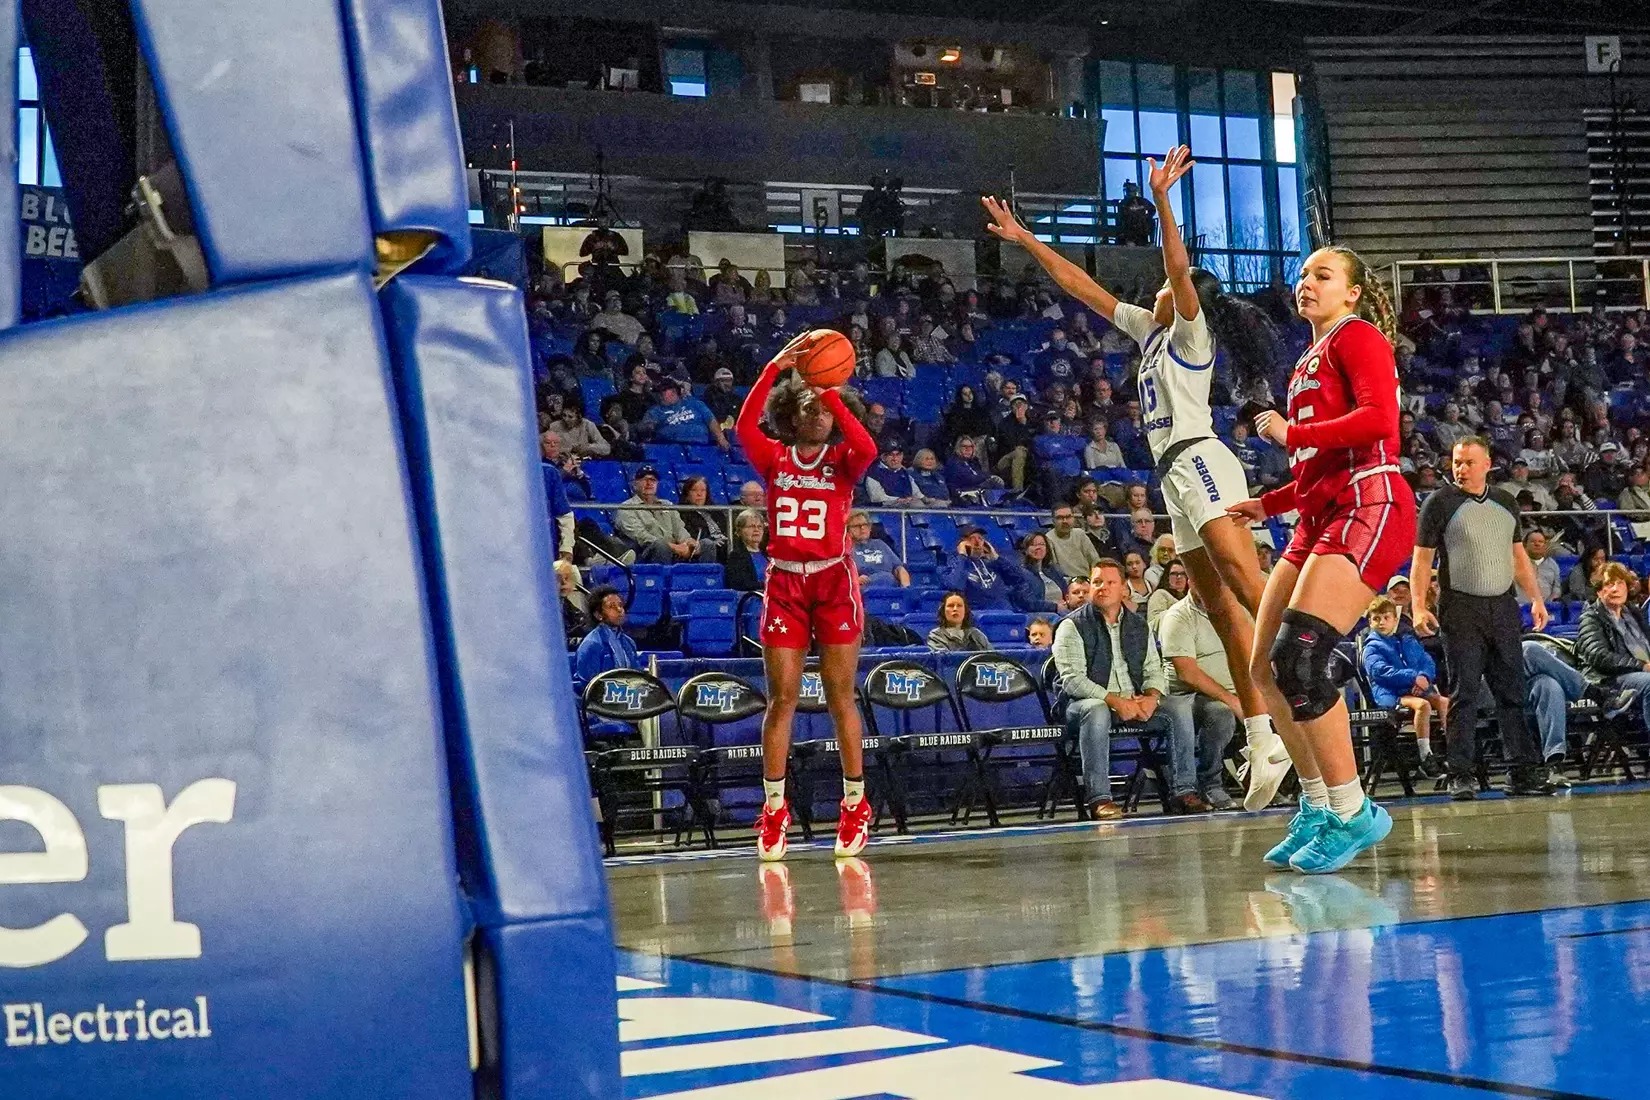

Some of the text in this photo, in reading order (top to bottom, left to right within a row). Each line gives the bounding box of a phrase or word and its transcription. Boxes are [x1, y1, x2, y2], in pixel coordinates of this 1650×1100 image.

[1597, 42, 1610, 64] F
[21, 193, 71, 224] BL
[1191, 455, 1221, 503] RAIDERS
[775, 496, 828, 540] 23
[885, 672, 925, 701] MT
[976, 664, 1015, 694] MT
[602, 680, 649, 710] MT
[696, 684, 742, 714] MT
[1361, 710, 1389, 721] RAIDERS
[919, 735, 971, 747] BLUE RAIDERS
[1011, 728, 1062, 740] BLUE RAIDERS
[630, 748, 687, 761] BLUE RAIDERS
[727, 748, 748, 759] BLUE
[4, 995, 211, 1047] Electrical
